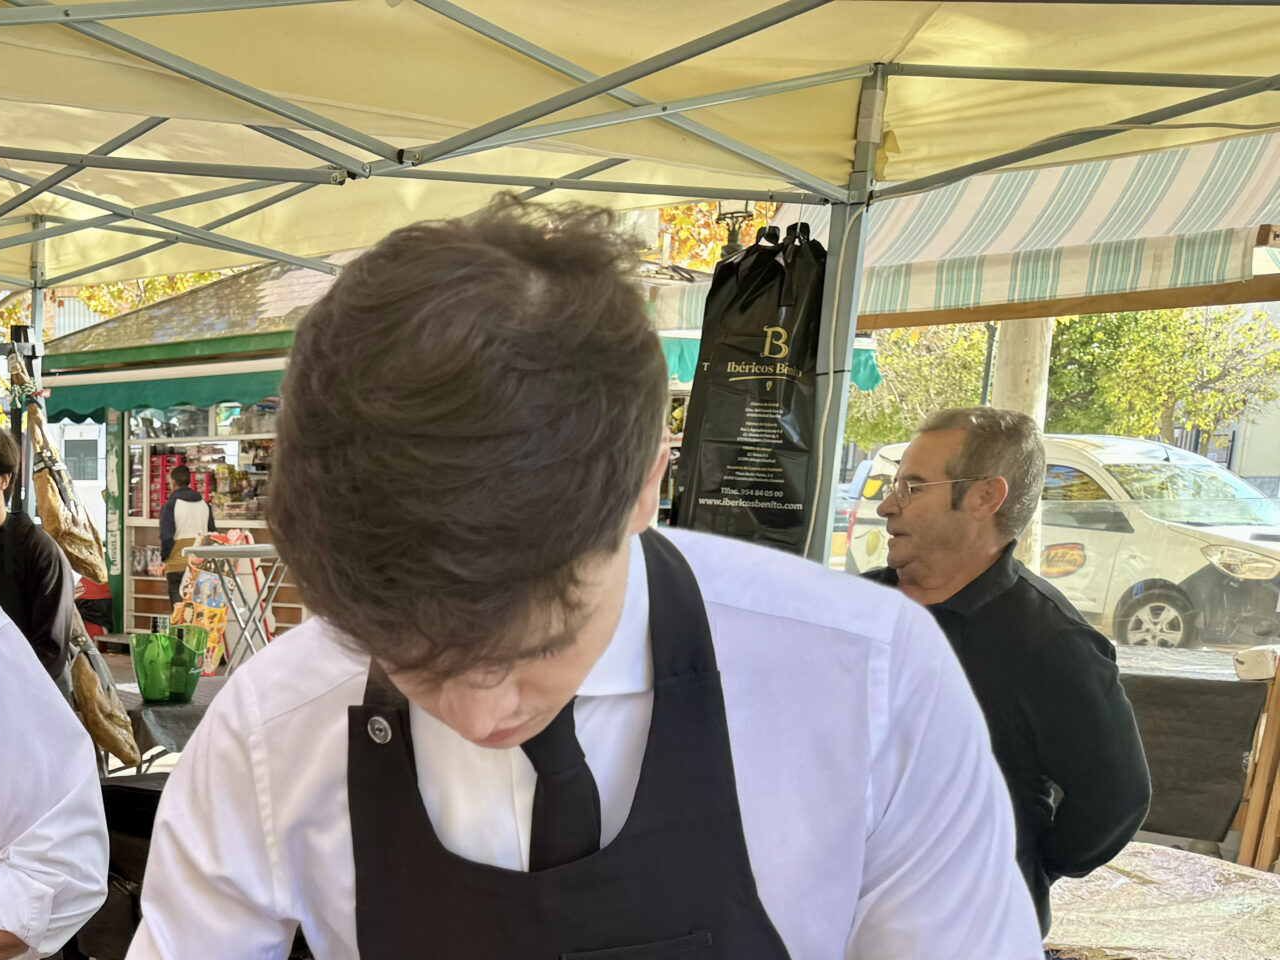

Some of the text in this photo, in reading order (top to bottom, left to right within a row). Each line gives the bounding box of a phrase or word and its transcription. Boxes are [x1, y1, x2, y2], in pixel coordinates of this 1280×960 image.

[760, 325, 789, 359] B
[726, 361, 774, 374] Ibéricos
[698, 497, 803, 511] www.ibericosbenito.com
